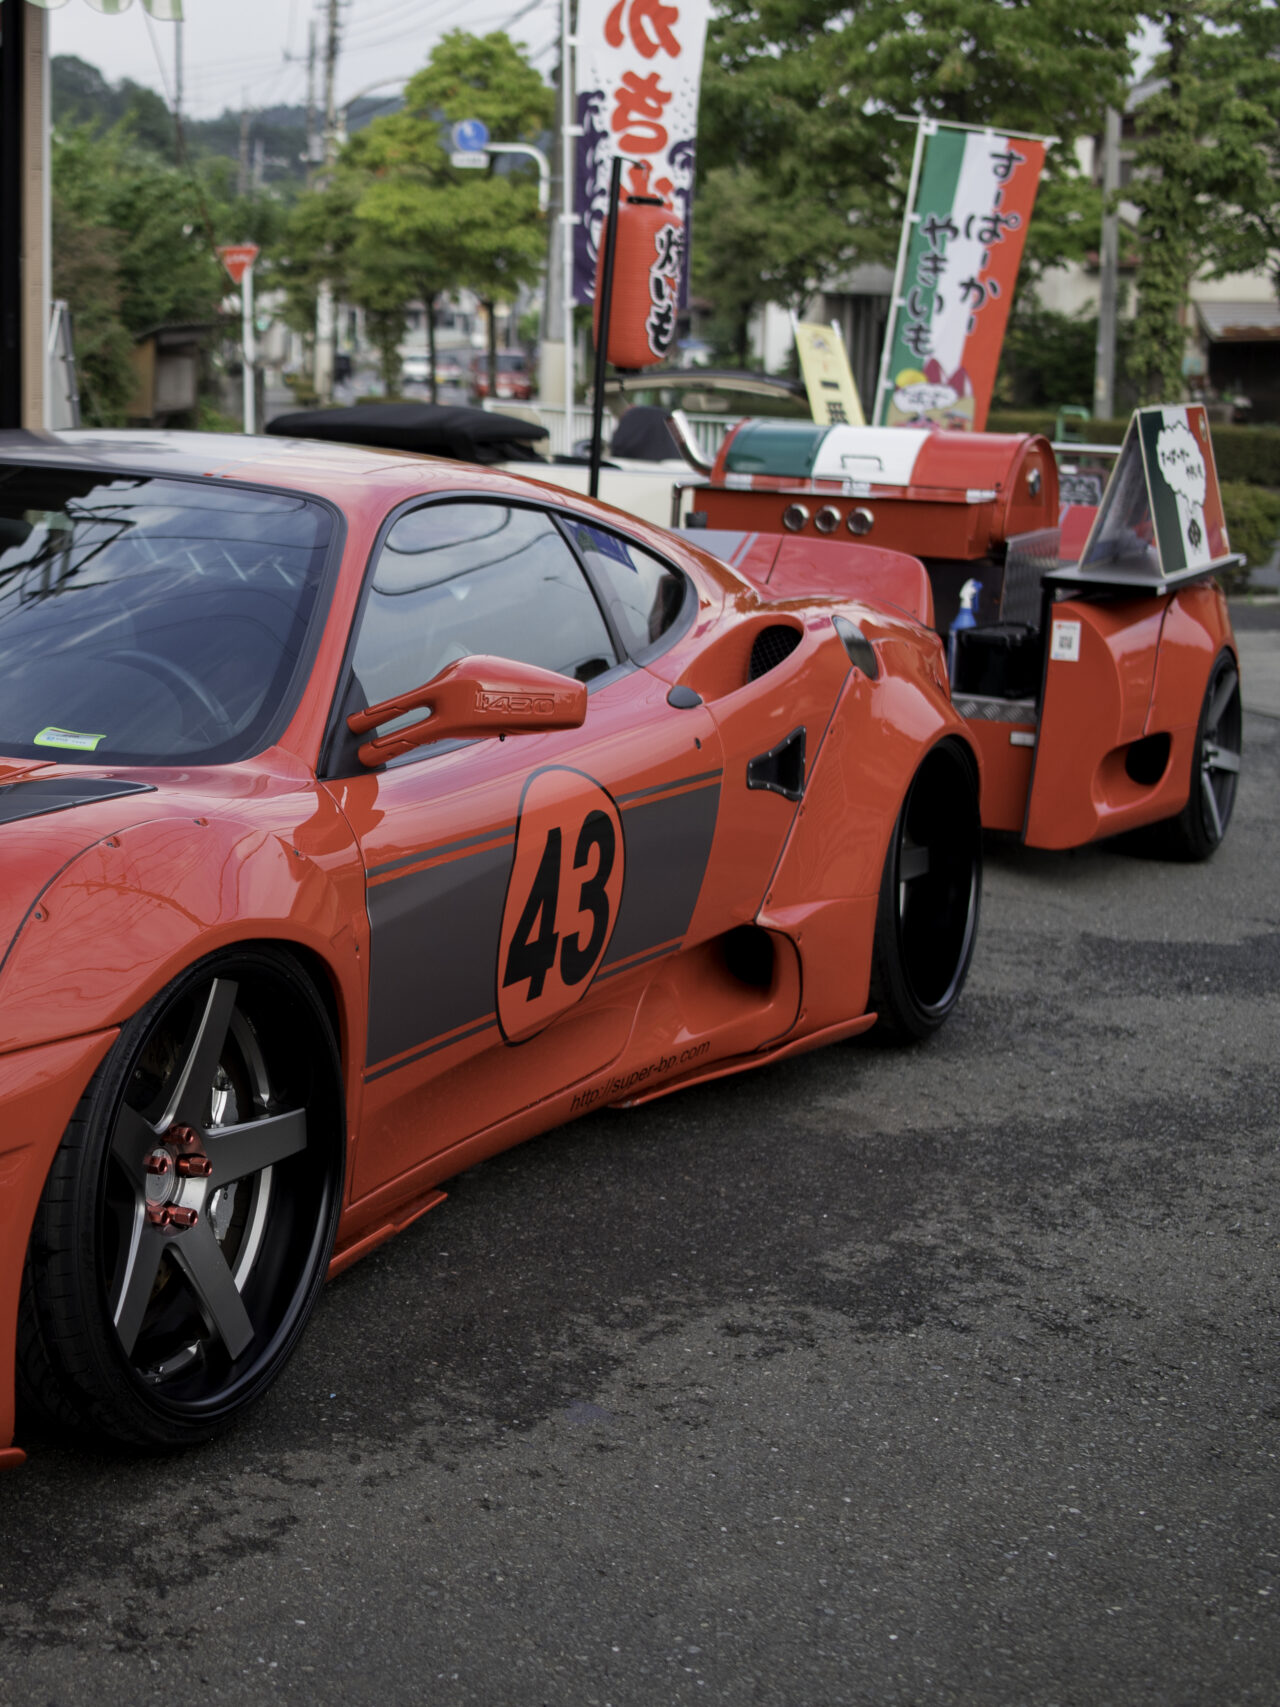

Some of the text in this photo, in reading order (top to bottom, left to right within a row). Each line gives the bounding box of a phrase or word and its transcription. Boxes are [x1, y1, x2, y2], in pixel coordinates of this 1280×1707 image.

[903, 215, 960, 356] やきいも
[474, 689, 555, 715] F430
[502, 809, 616, 1003] 43
[570, 1040, 711, 1113] http://super-bp.com
